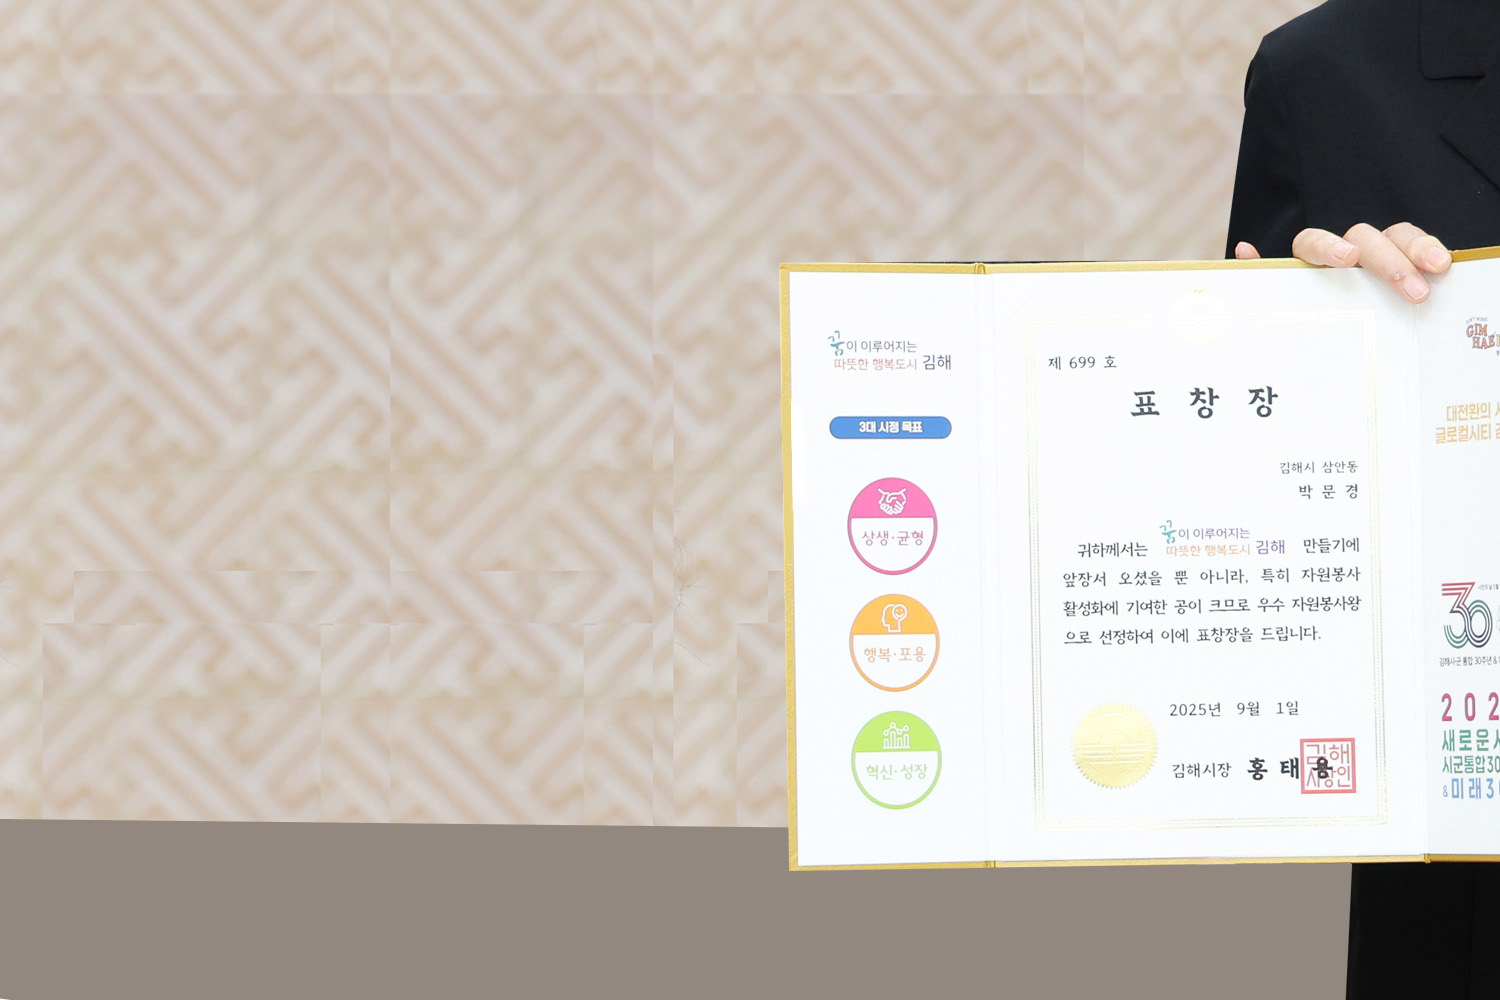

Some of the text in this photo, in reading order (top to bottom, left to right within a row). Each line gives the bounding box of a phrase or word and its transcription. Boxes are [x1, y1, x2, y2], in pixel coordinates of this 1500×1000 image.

[1466, 323, 1488, 338] GIM
[861, 340, 918, 353] 이루어지는
[834, 354, 952, 371] 따뜻한 행복도시 김해
[1047, 355, 1118, 370] 제 699 호
[1446, 401, 1491, 422] 대전환의
[858, 420, 924, 434] 3대 시정 목표
[1435, 422, 1492, 444] 글로컬시티
[1279, 460, 1358, 474] 김해시 삼안동
[1193, 527, 1250, 540] 이루어지는
[1077, 537, 1360, 558] 귀하께서는 따뜻한 행복도시 김해 만들기에
[1062, 566, 1361, 587] 앞장서 오셨을 뿐 아니라, 특히 자원봉사
[1062, 596, 1362, 616] 활성화에 기여한 공이 크므로 우수 자원봉사왕
[1441, 582, 1493, 649] 30
[1063, 625, 1322, 645] 으로 선정하여 이에 표창장을 드립니다.
[1169, 700, 1299, 717] 2025년 9월 1일
[1172, 762, 1232, 778] 김해시장
